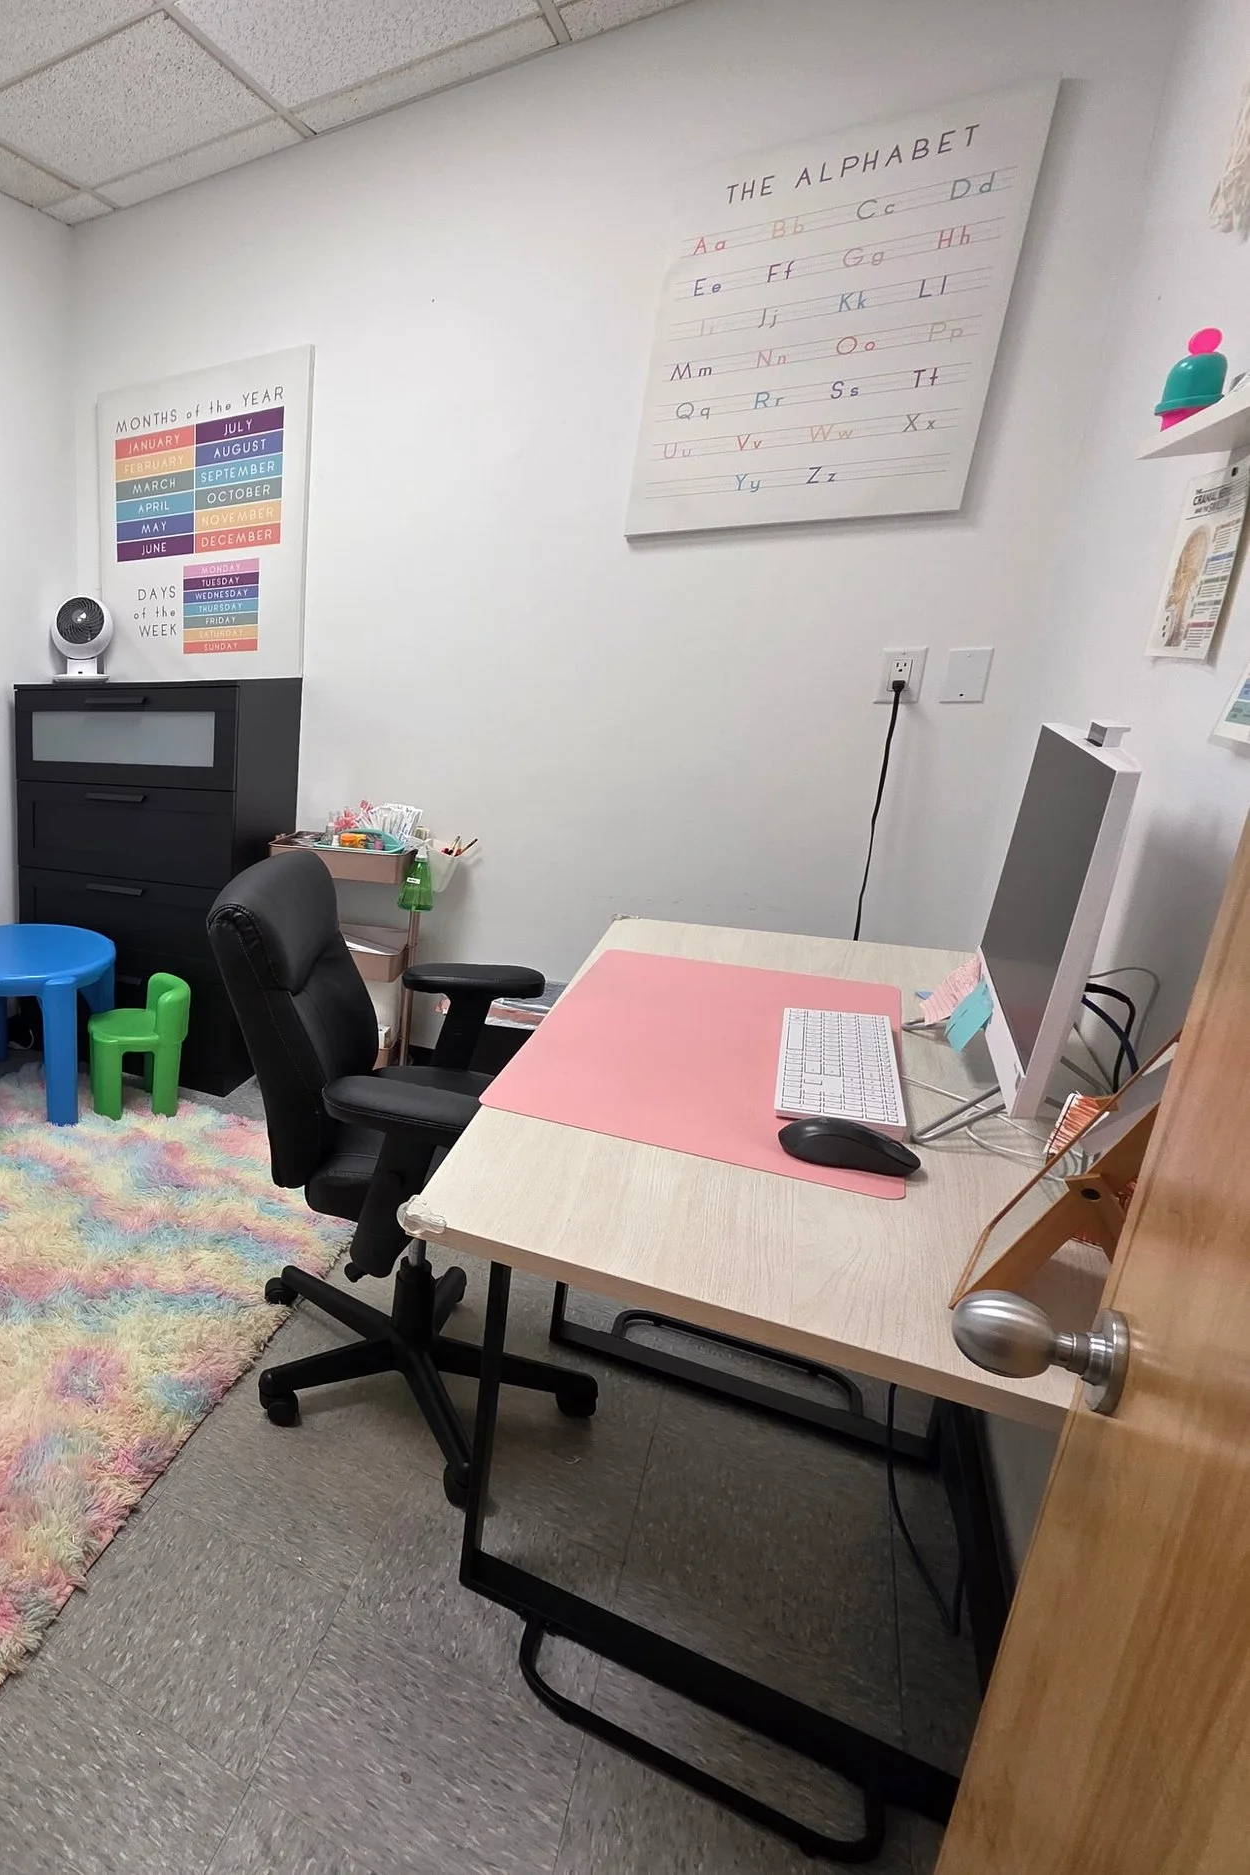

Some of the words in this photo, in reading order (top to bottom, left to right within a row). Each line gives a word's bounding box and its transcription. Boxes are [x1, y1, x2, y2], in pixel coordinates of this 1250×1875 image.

[727, 176, 775, 204] THE
[795, 124, 980, 188] ALPHABET
[116, 409, 177, 434] MONTHS
[186, 402, 200, 419] of
[210, 400, 231, 415] the
[242, 386, 284, 408] YEAR
[224, 419, 253, 436] JULY
[128, 434, 180, 454] JANUARY
[213, 439, 266, 458] AUGUST
[124, 455, 184, 474] FEBRUARY
[201, 461, 275, 483] SEPTEMBER
[132, 479, 176, 493] MARCH
[207, 484, 270, 504] OCTOBER
[138, 500, 170, 512] APRIL
[202, 507, 274, 526] NOVEMBER
[142, 522, 167, 533] MAY
[201, 529, 272, 547] DECEMBER
[141, 543, 166, 555] JUNE
[200, 564, 241, 574] MONDAY
[201, 576, 240, 587] TUESDAY
[138, 586, 176, 600] DAYS
[195, 588, 248, 599] WEDNESDAY
[134, 608, 146, 619] of
[155, 606, 176, 618] the
[199, 603, 242, 612] THURSDAY
[205, 616, 236, 624] FRIDAY
[139, 624, 177, 637] WEEK
[199, 629, 243, 638] SATURDAY
[204, 642, 238, 651] SUNDAY
